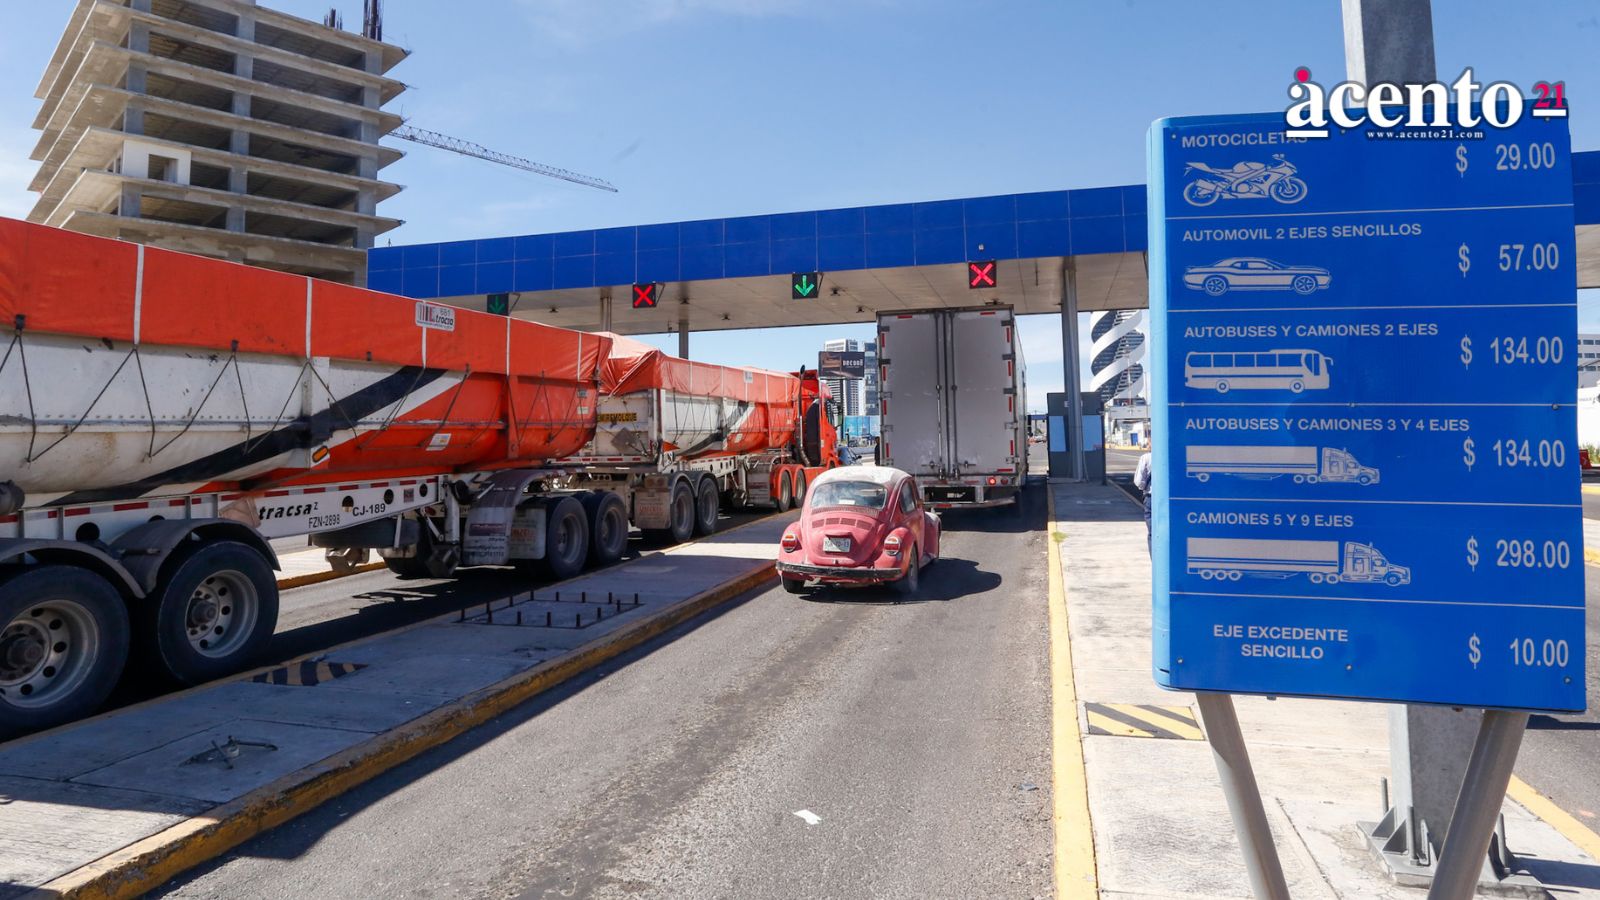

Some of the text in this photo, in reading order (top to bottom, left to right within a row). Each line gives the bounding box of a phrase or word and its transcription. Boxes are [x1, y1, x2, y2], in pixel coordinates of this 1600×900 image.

[1456, 142, 1556, 177] $ 29.00
[1183, 223, 1422, 241] AUTOMOVIL 2 EJES SENCILLOS
[1459, 242, 1559, 278] $ 57.00
[1184, 323, 1438, 338] AUTOBUSES Y CAMIONES 2 EJES
[1461, 336, 1564, 370] $ 134.00
[1185, 418, 1470, 432] AUTOBUSES Y CAMIONES 3 Y 4 EJES
[1464, 437, 1565, 471] $ 134.00
[259, 502, 312, 520] tracsa
[352, 503, 386, 517] CJ-189
[1186, 511, 1354, 528] CAMIONES 5 Y 9 EJES
[1467, 537, 1570, 571] $ 298.00
[1213, 624, 1348, 642] EJE EXCEDENTE
[1241, 643, 1324, 660] SENCILLO
[1469, 633, 1569, 669] $ 10.00
